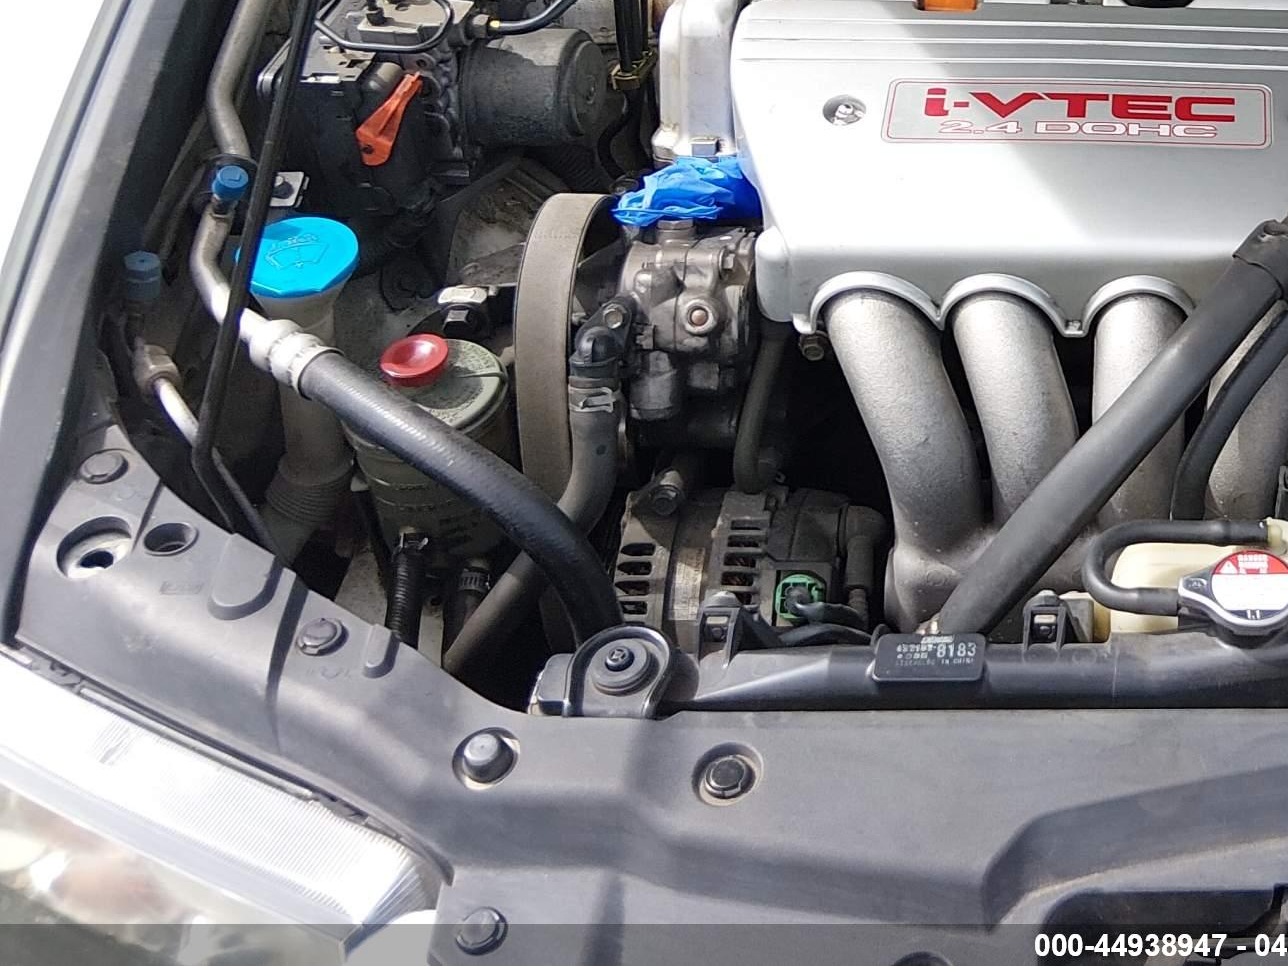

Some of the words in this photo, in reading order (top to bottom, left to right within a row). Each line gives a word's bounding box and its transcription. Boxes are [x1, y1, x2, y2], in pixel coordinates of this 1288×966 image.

[924, 87, 1236, 123] i-VTEC
[939, 120, 1023, 135] 2.4
[1034, 121, 1218, 138] DOHC
